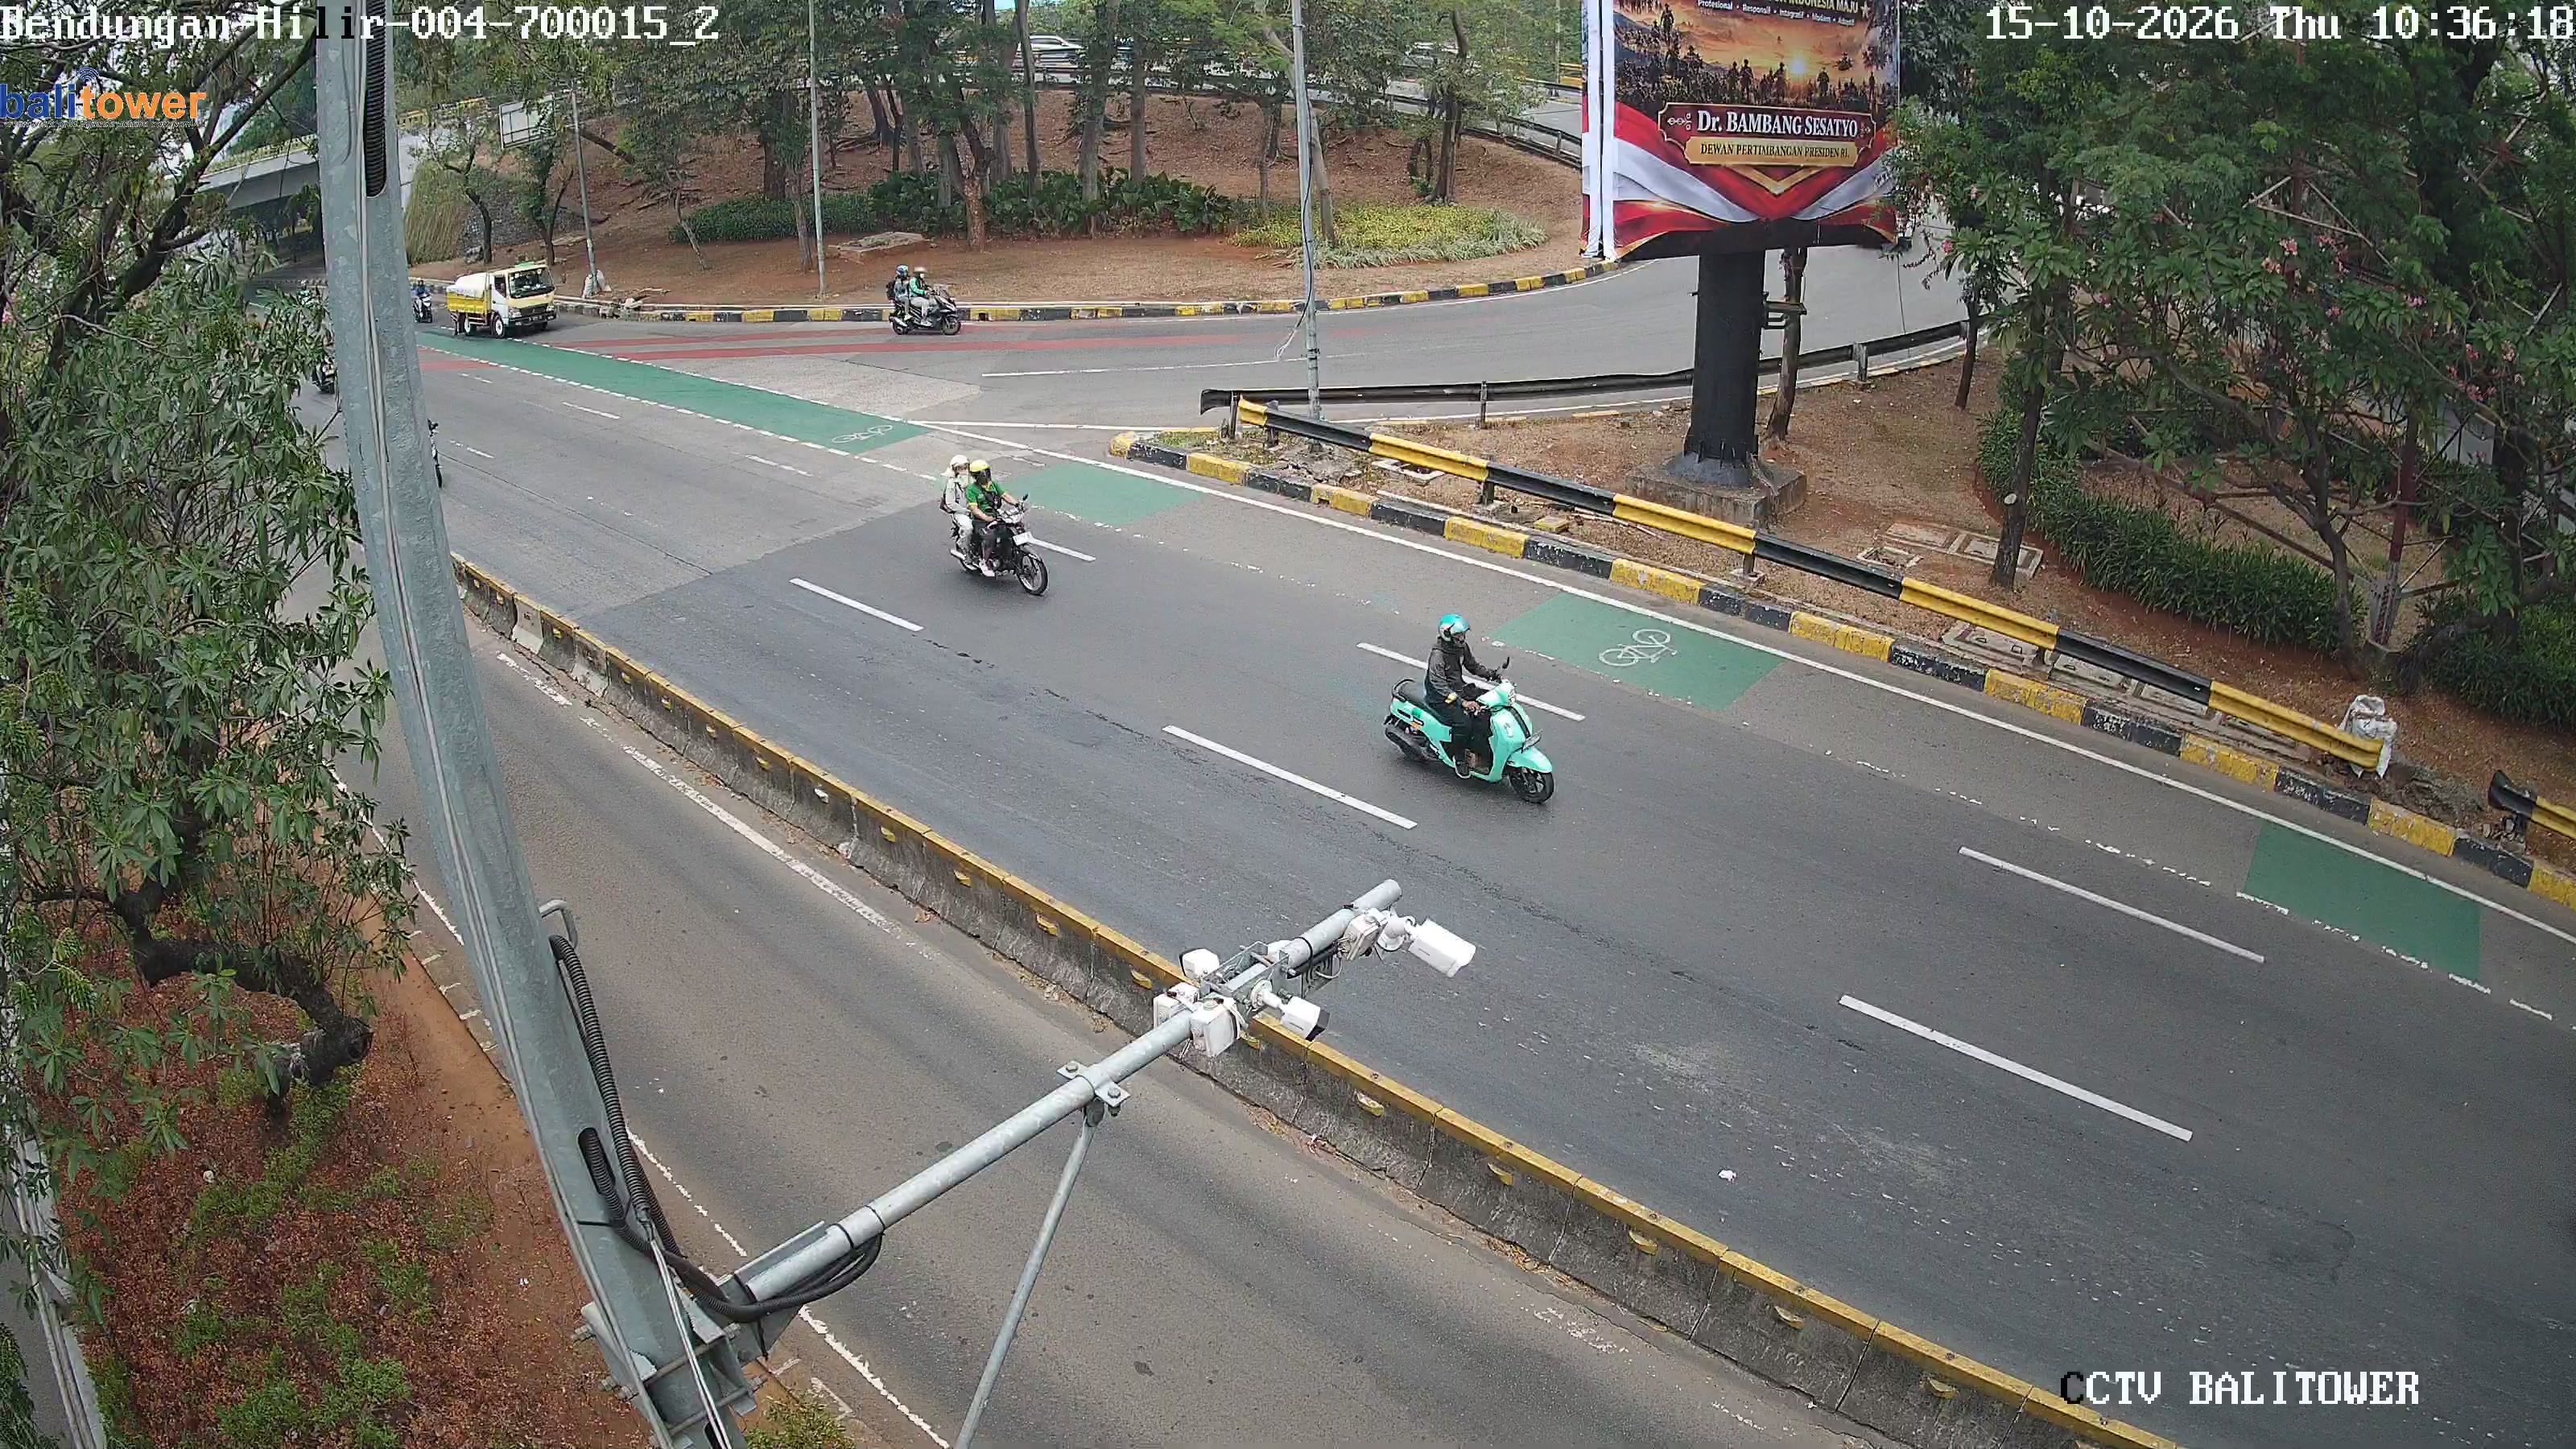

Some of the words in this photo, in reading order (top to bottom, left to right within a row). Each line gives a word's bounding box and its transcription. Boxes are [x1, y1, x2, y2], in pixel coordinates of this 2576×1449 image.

[1835, 0, 1860, 13] MAJU
[1697, 109, 1723, 132] Dr.
[1726, 111, 1803, 135] BAMBANG
[1804, 115, 1859, 138] SESATYO
[1700, 142, 1733, 155] DEWAN
[1736, 143, 1803, 157] PERTIMBANGAN
[1804, 145, 1839, 158] PRESIDEN
